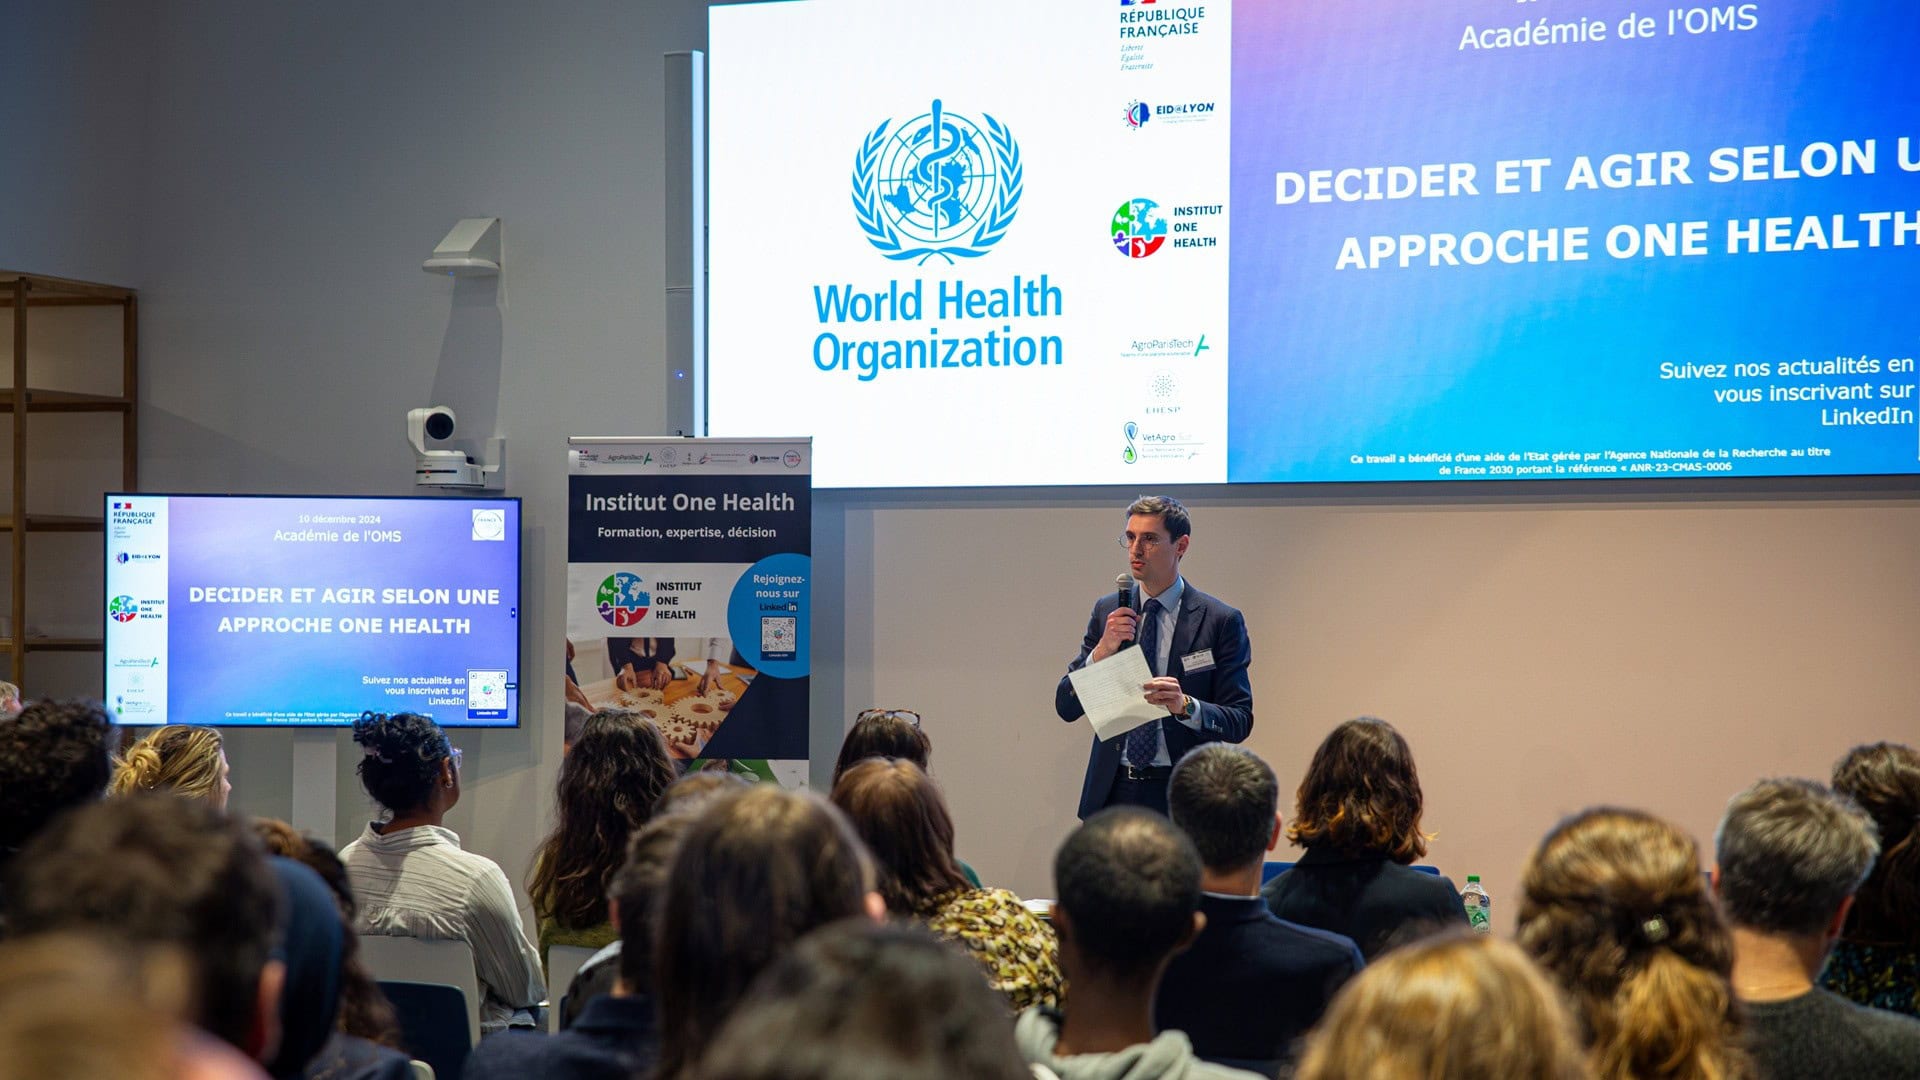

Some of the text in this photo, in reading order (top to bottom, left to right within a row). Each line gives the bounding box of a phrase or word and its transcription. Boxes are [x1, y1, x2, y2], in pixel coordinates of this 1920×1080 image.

[1120, 7, 1205, 23] RÉPUBLIQUE
[1120, 23, 1199, 38] FRANÇAISE
[1458, 4, 1758, 50] Académie de l'OMS
[1276, 163, 1480, 205] DECIDER
[1496, 158, 1552, 194] ET
[1565, 151, 1694, 190] AGIR
[1708, 139, 1876, 183] SELON
[1174, 205, 1223, 216] INSTITUT
[1174, 222, 1198, 232] ONE
[1174, 237, 1217, 248] HEALTH
[1335, 210, 1920, 270] APPROCHE ONE HEALTH
[813, 274, 1063, 323] World Health
[1131, 339, 1194, 352] AgroParisTech
[813, 325, 1063, 381] Organization
[1659, 355, 1914, 379] Suivez nos actualités en
[1714, 383, 1915, 403] vous inscrivant sur
[1822, 407, 1913, 426] LinkedIn
[1142, 434, 1176, 443] VetAgro
[1351, 455, 1363, 464] Ce
[1366, 454, 1396, 463] travail
[1484, 453, 1505, 462] aide
[1508, 452, 1521, 461] de
[1552, 451, 1580, 463] gérée
[1584, 453, 1601, 462] par
[1650, 449, 1699, 459] Nationale
[1702, 448, 1715, 458] de
[1719, 448, 1729, 458] la
[1732, 447, 1787, 458] Recherche
[1791, 449, 1804, 457] au
[1807, 447, 1831, 457] titre
[1439, 466, 1451, 475] de
[1455, 466, 1486, 475] France
[1489, 465, 1513, 474] 2030
[1516, 465, 1552, 476] portant
[1555, 464, 1565, 473] la
[1568, 462, 1617, 473] référence
[586, 492, 795, 512] Institut One Health
[299, 514, 381, 524] 10 décembre 2024
[274, 529, 402, 542] Académie de l'OMS
[598, 526, 776, 540] Formation, expertise, décision
[656, 582, 702, 591] INSTITUT
[753, 574, 805, 586] Rejoignez-
[189, 587, 500, 605] DECIDER ET AGIR SELON UNE
[656, 596, 679, 605] ONE
[756, 590, 800, 598] nous sur
[656, 611, 696, 620] HEALTH
[218, 617, 470, 634] APPROCHE ONE HEALTH
[362, 676, 465, 685] Suivez nos actualités en
[385, 687, 465, 695] vous inscrivant sur
[428, 697, 465, 705] LinkedIn
